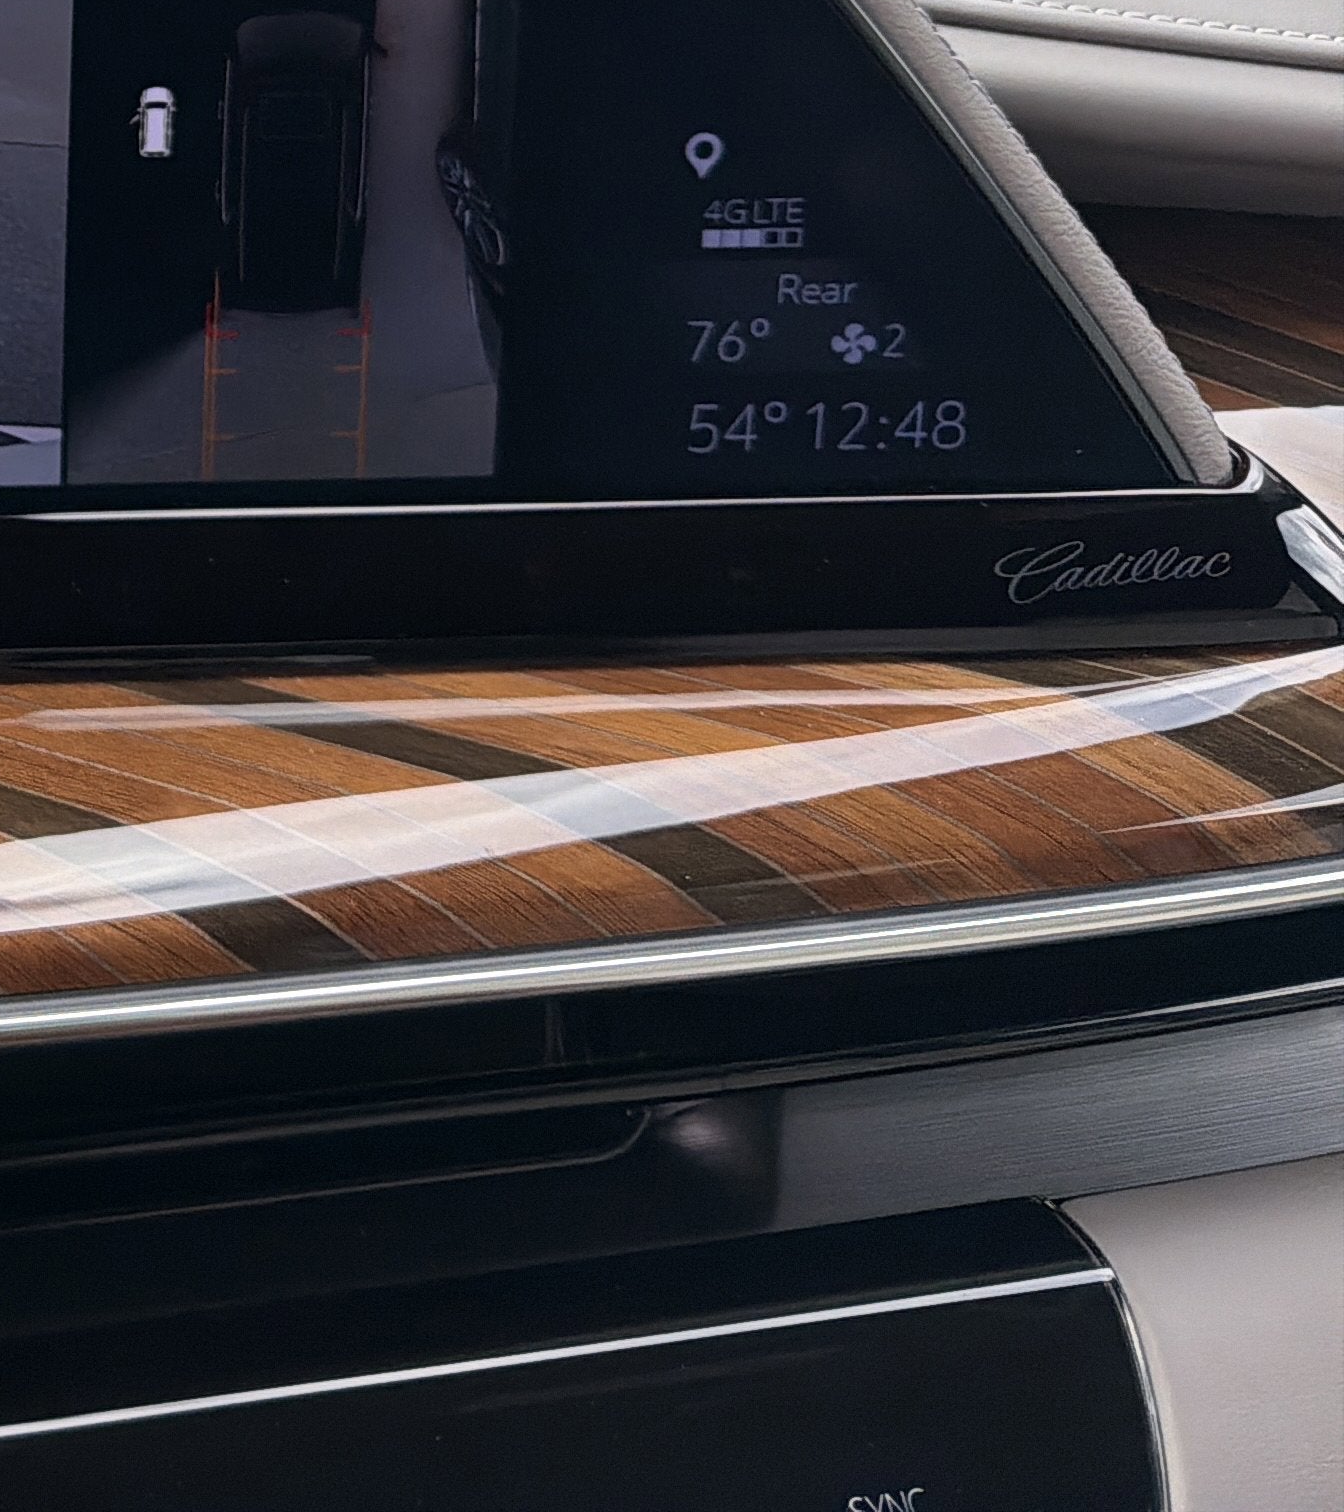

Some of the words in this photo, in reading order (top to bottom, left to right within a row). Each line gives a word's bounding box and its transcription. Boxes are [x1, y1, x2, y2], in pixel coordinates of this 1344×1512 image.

[776, 273, 859, 306] Rear
[686, 317, 771, 363] 76°
[881, 322, 907, 359] 2
[686, 400, 789, 454] 54°
[805, 399, 967, 451] 12:48
[993, 540, 1232, 605] Cadillac
